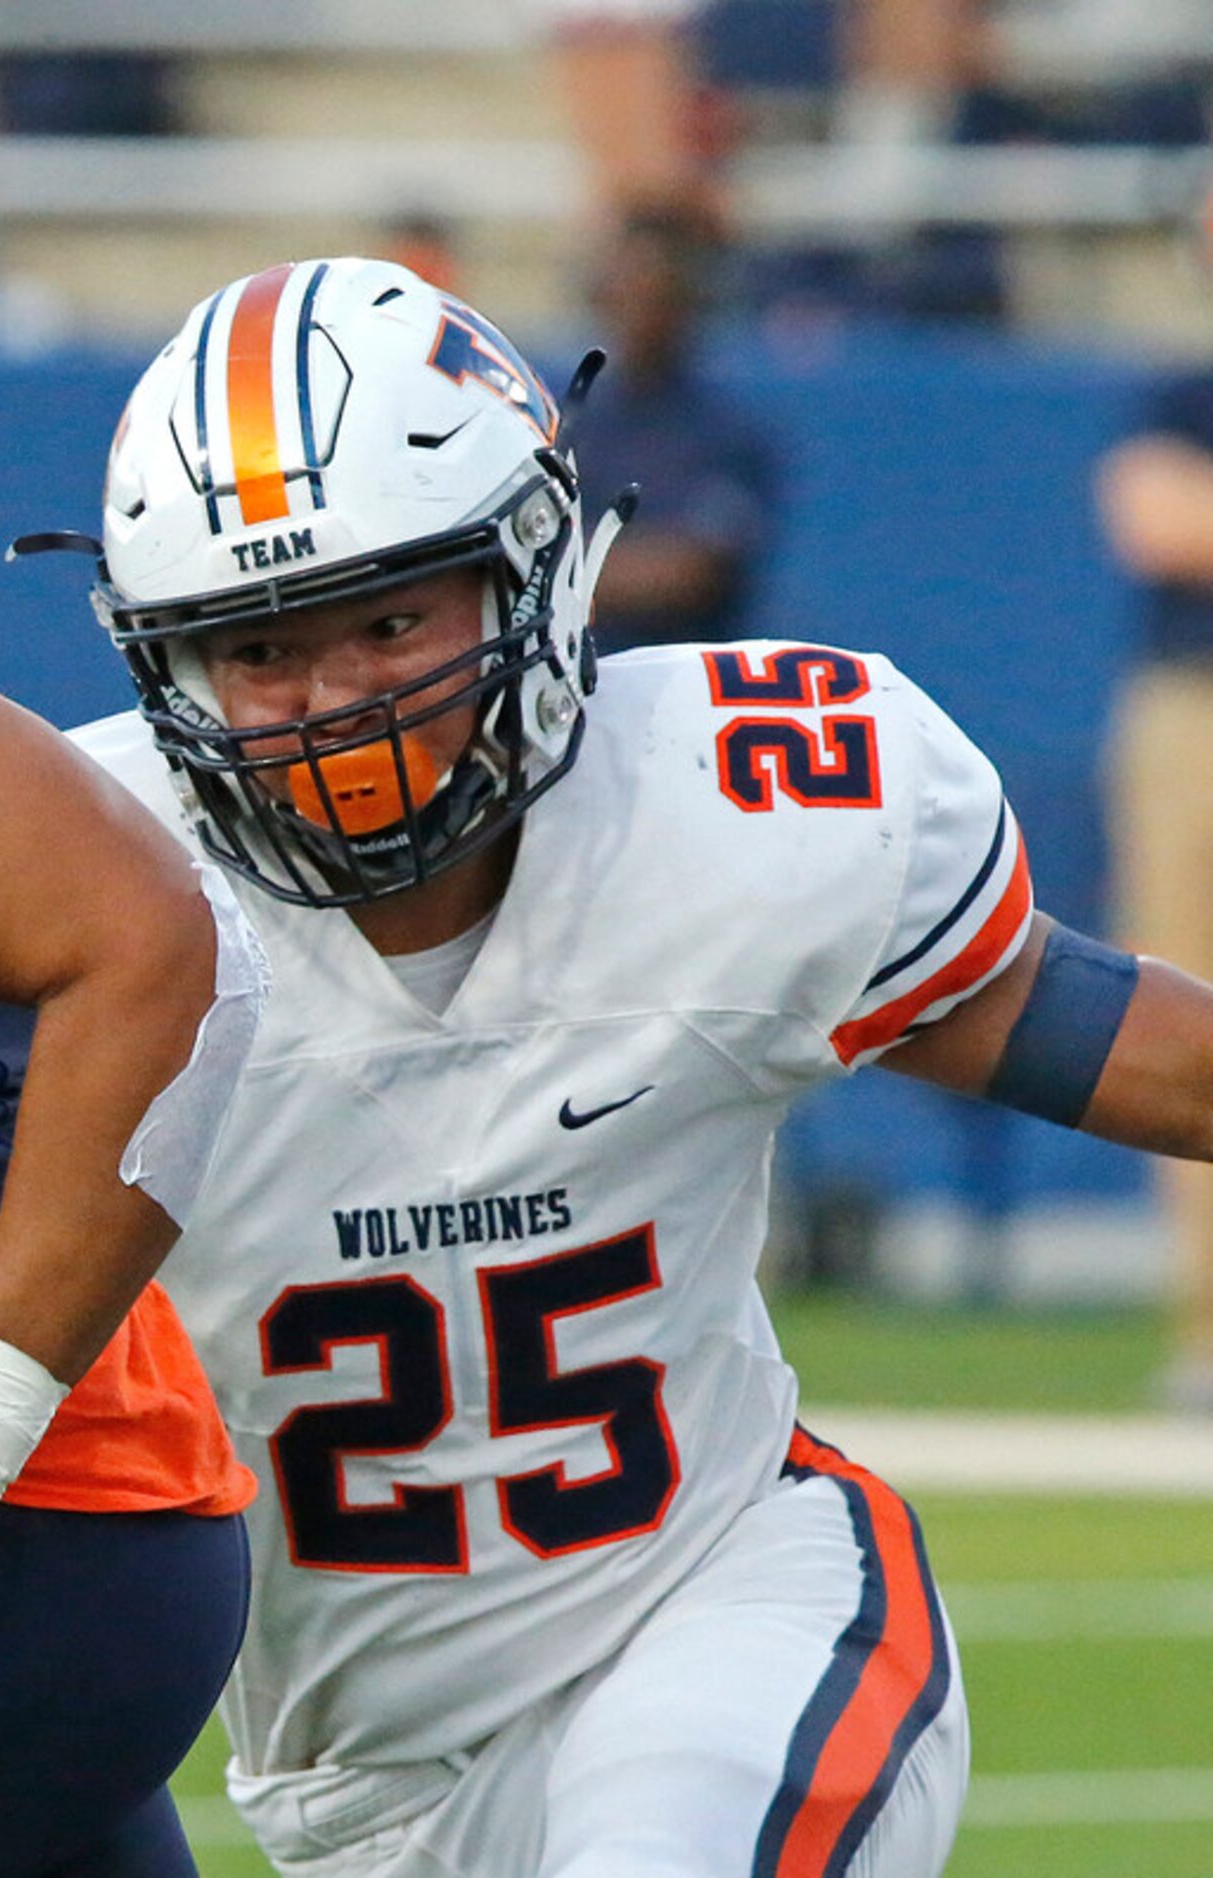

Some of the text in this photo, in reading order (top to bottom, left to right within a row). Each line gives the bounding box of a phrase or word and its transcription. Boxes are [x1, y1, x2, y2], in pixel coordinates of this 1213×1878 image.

[231, 527, 316, 571] TEAM
[701, 647, 882, 813] 25
[332, 1188, 572, 1260] WOLVERINES
[258, 1220, 682, 1575] 25
